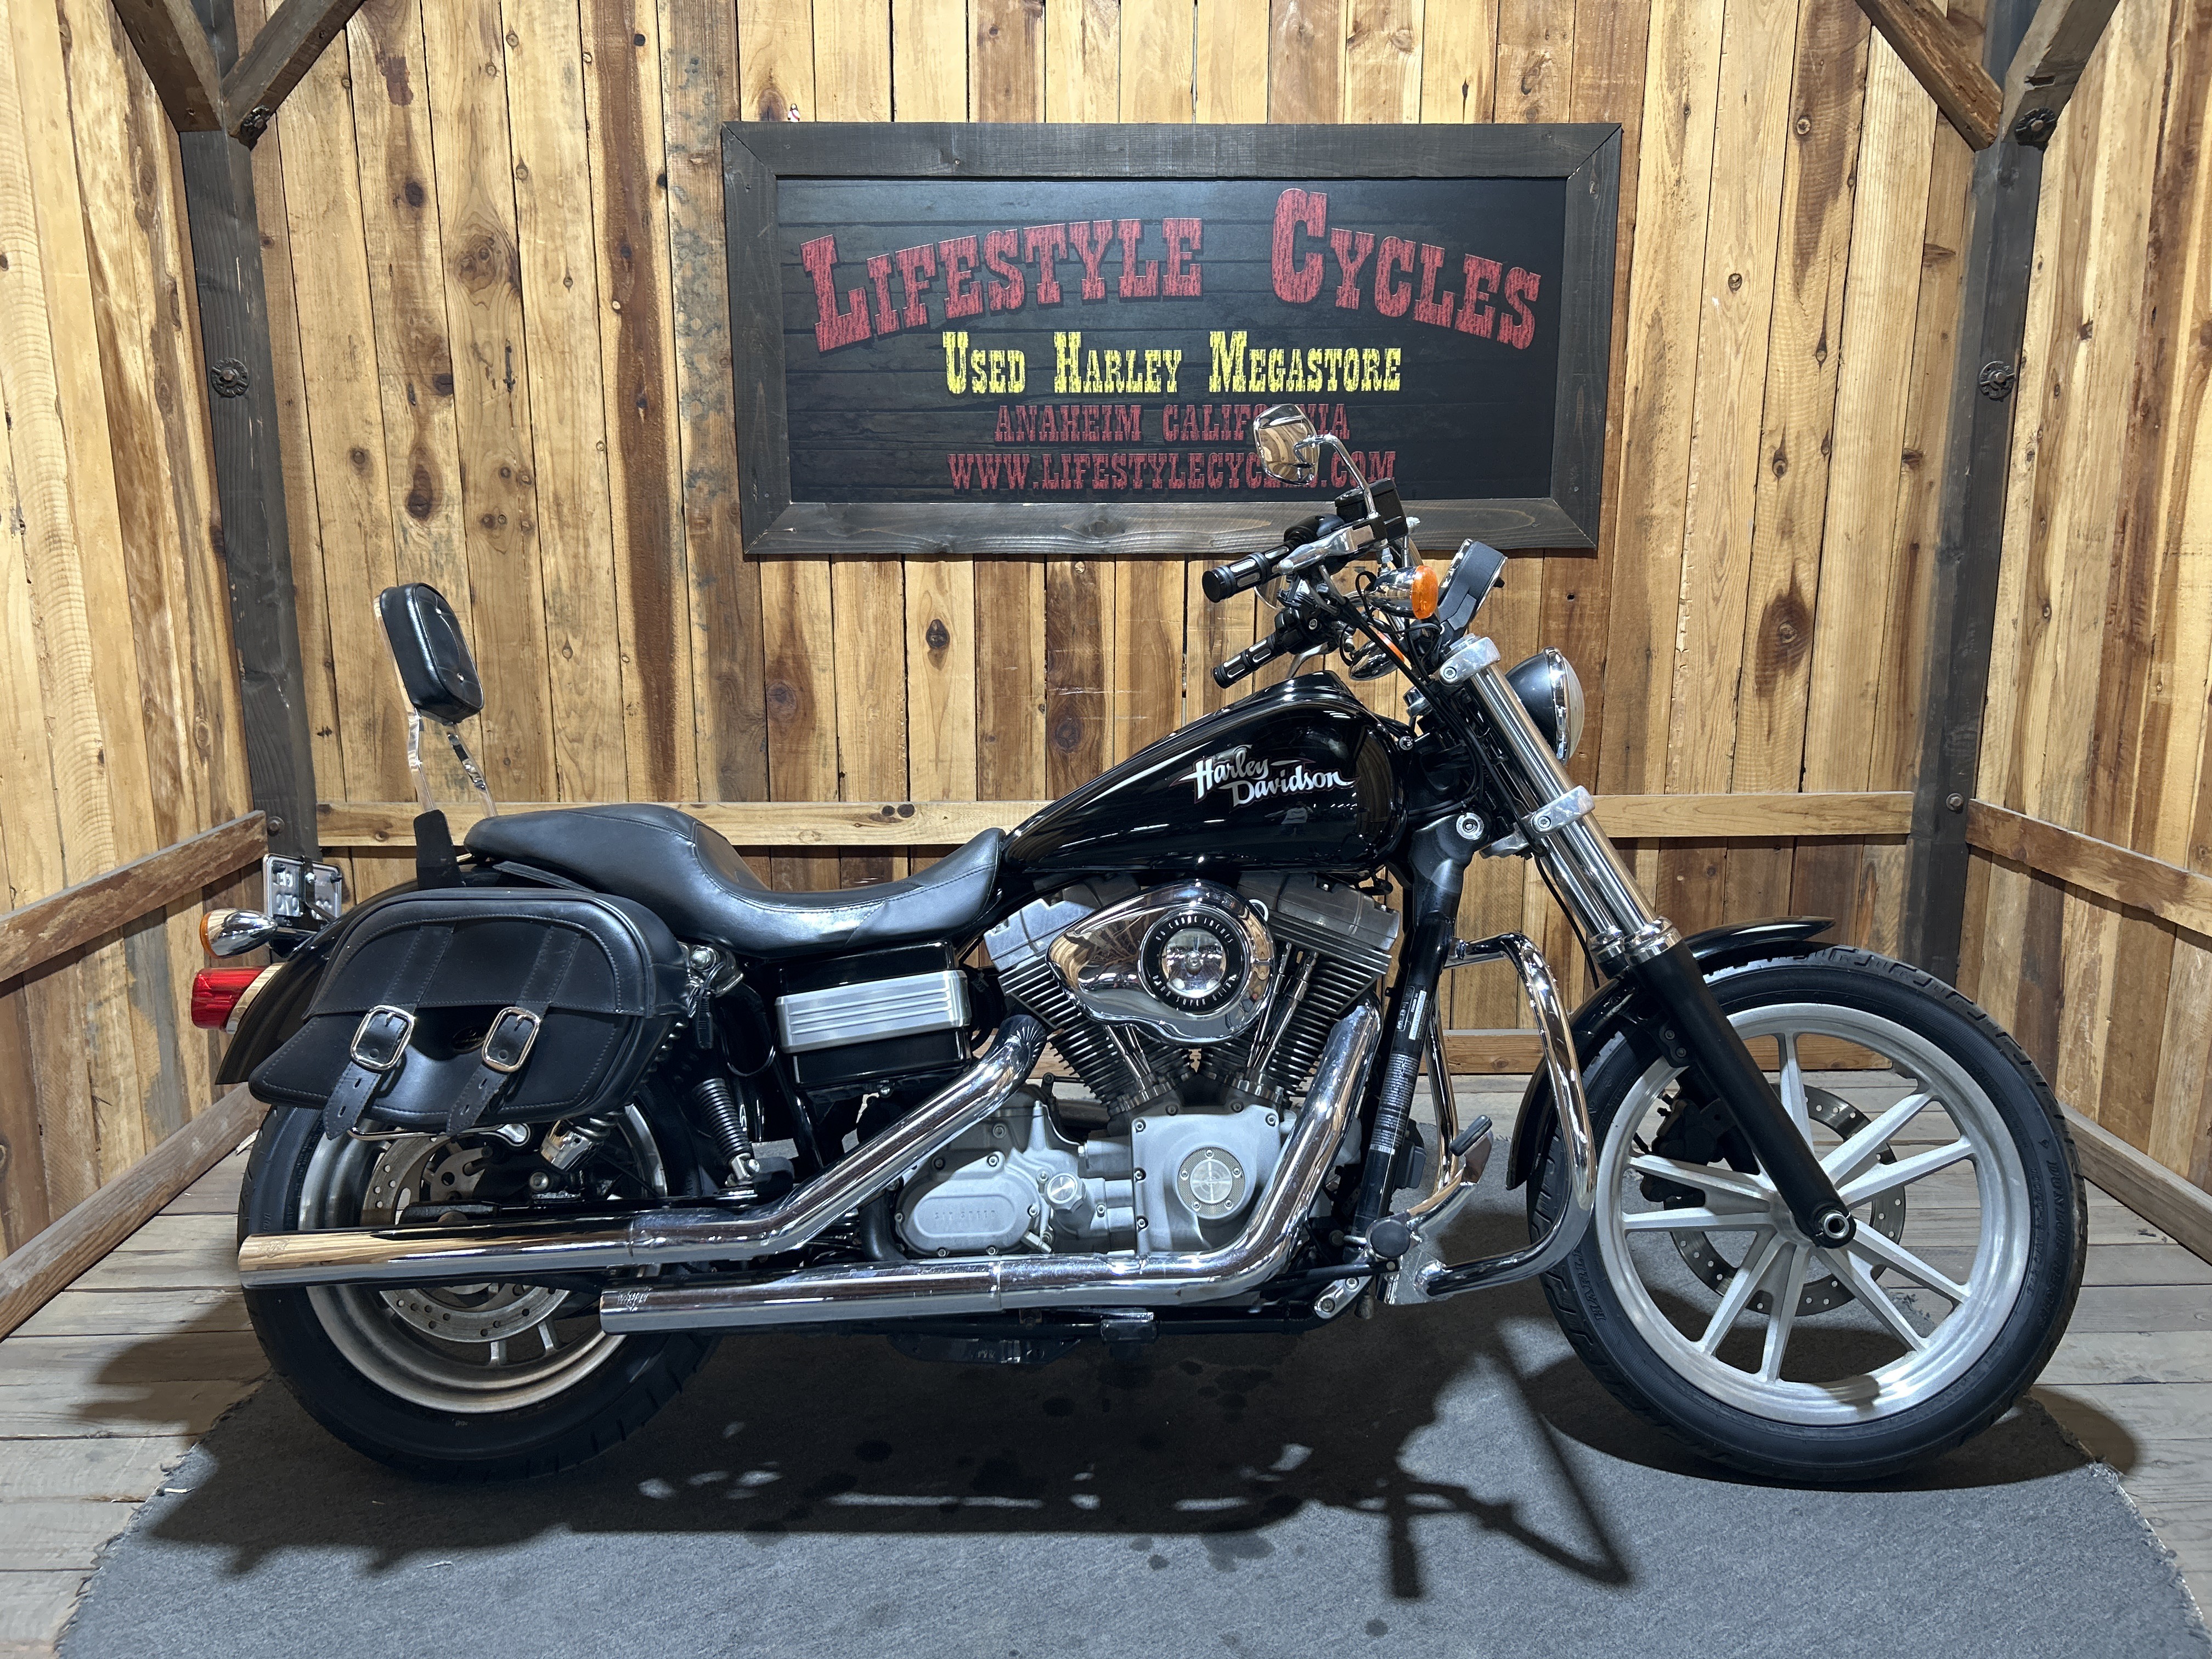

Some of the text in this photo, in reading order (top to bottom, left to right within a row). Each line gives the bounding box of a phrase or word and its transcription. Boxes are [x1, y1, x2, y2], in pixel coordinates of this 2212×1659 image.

[800, 188, 1541, 352] LIFESTYLE CYCLES
[942, 331, 1402, 394] USED HARLEY MEGASTORE
[994, 404, 1142, 442] ANAHEIM
[946, 451, 1397, 490] WWW.LIFESTYLECYC.COM
[1171, 744, 1268, 801] Harley
[1219, 762, 1357, 808] Davidson
[1155, 930, 1166, 941] 96
[1204, 917, 1233, 943] INCHES
[1176, 997, 1206, 1006] SUPER
